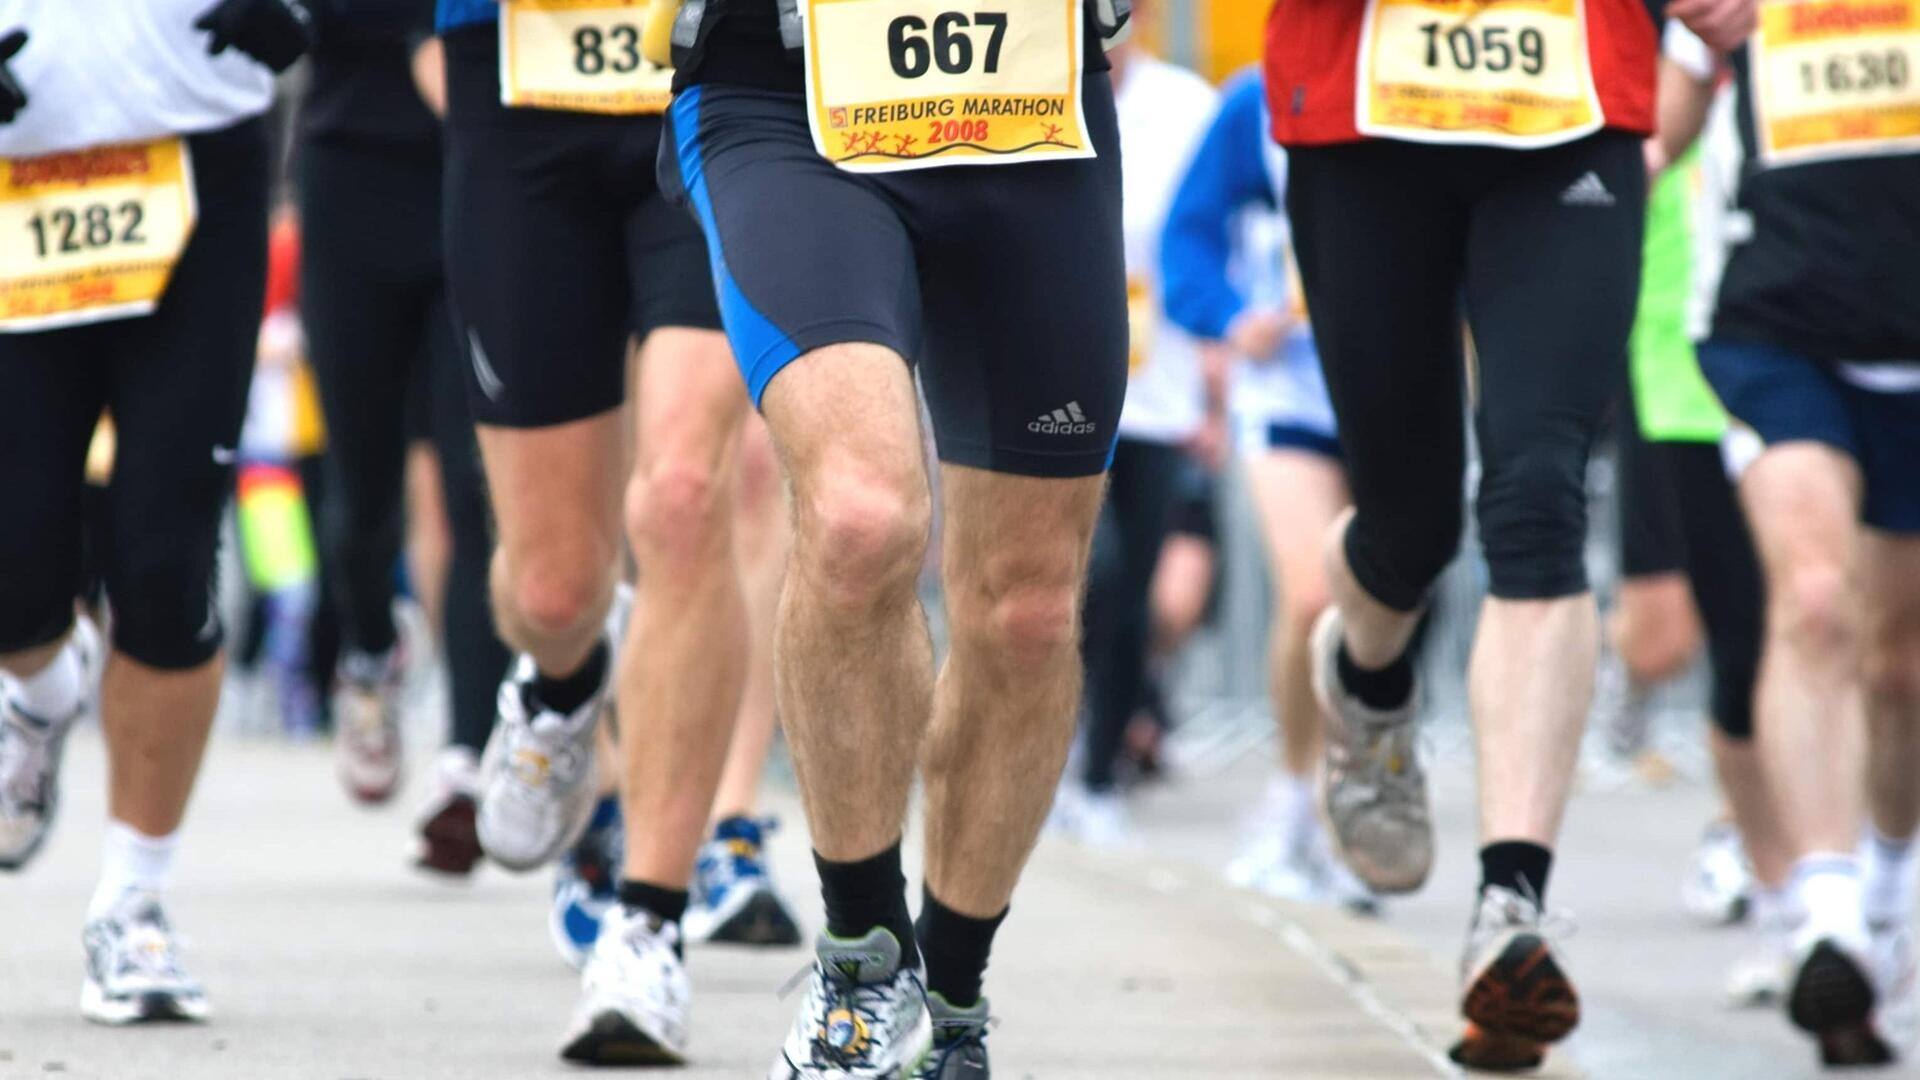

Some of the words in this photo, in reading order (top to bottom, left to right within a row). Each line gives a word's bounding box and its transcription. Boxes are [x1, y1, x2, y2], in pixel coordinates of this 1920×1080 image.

[573, 24, 664, 75] 83
[887, 11, 1008, 79] 667
[1419, 21, 1546, 76] 1059
[853, 99, 955, 125] FREIBURG
[961, 98, 1065, 117] MARATHON
[927, 119, 989, 144] 2008
[28, 201, 147, 257] 1282
[1027, 420, 1096, 435] adidas
